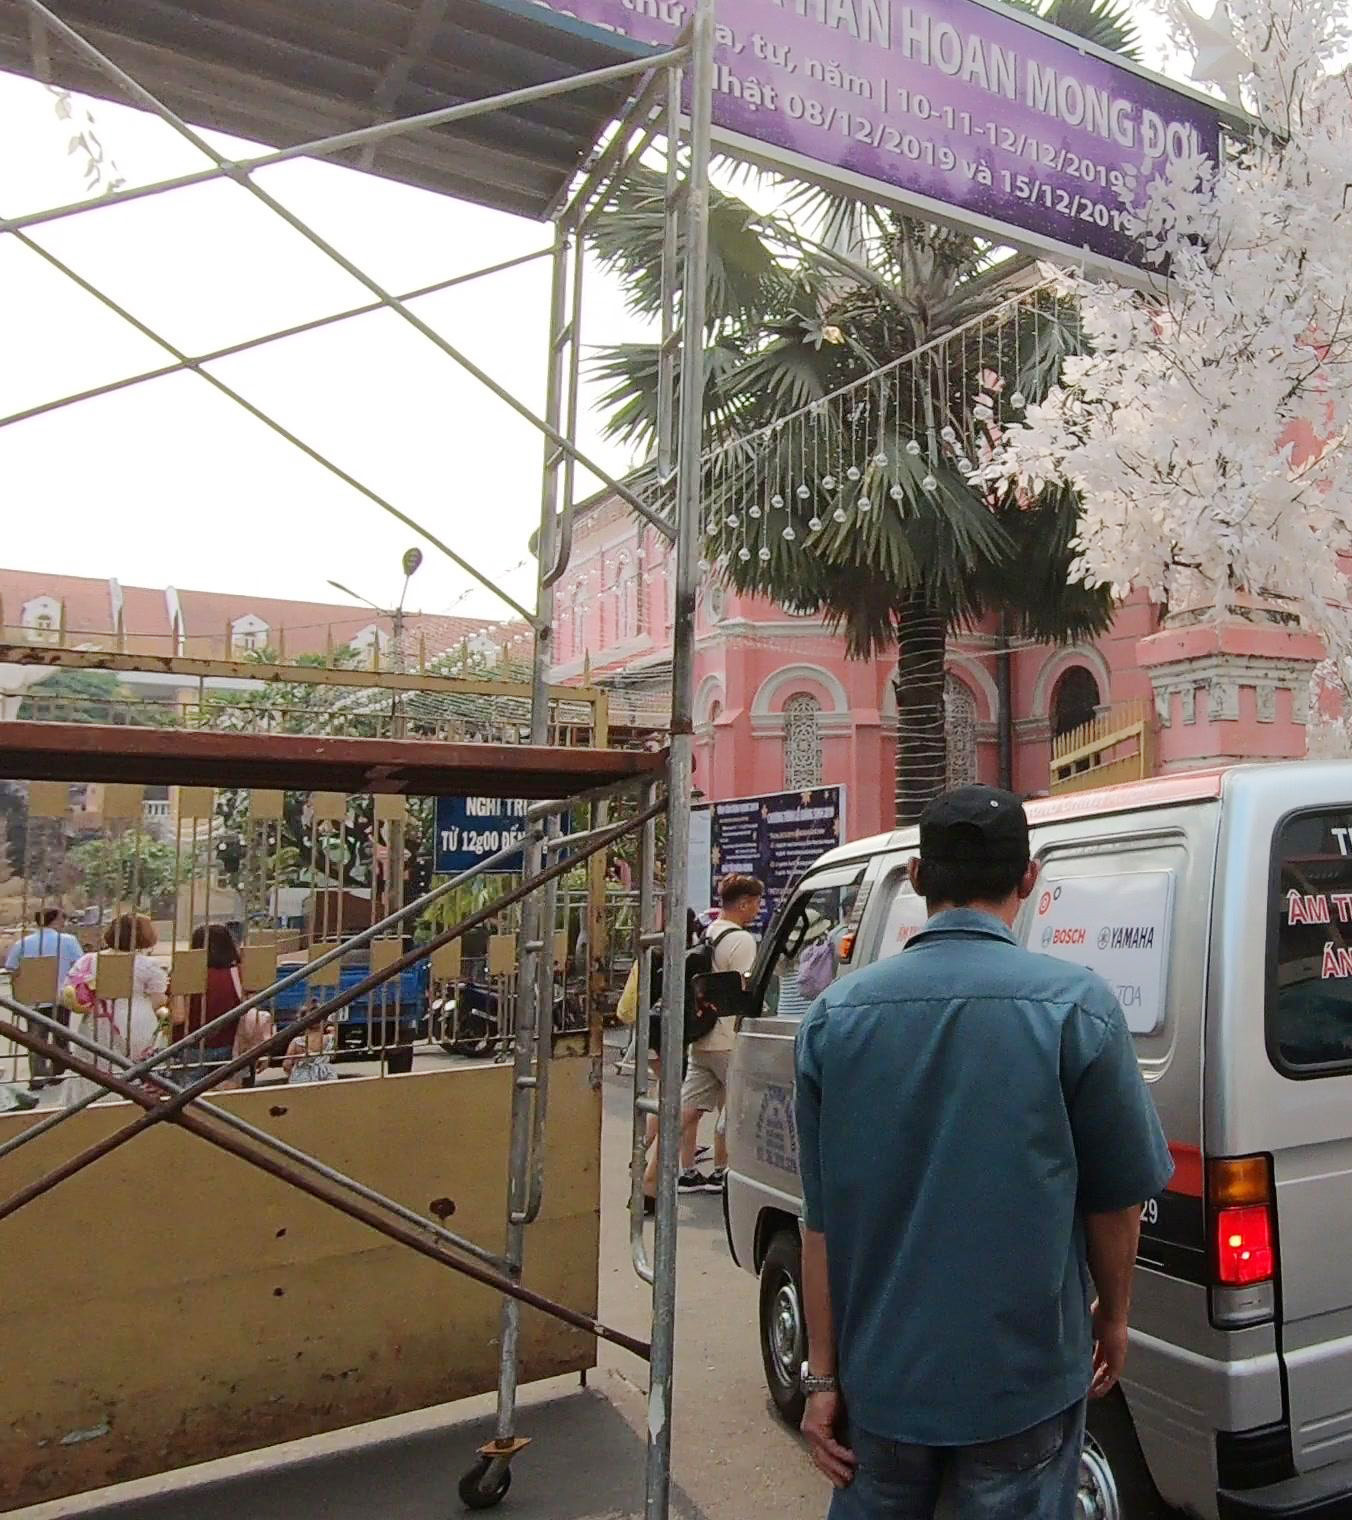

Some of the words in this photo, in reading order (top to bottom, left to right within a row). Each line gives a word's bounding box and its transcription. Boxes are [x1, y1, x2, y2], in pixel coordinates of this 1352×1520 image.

[902, 6, 1017, 100] HOAN
[1026, 60, 1136, 148] MONG
[752, 33, 797, 73] tư,
[807, 56, 873, 98] năm
[898, 87, 1126, 190] 10-11-12/12/2019
[785, 94, 958, 172] 08/12/2019
[962, 160, 993, 188] và
[1001, 168, 1138, 237] 15/12/2019
[441, 825, 460, 852] TỪ
[461, 830, 499, 855] 12g00
[1286, 889, 1331, 926] ÂM
[1052, 928, 1086, 945] BOSCH
[1110, 926, 1155, 949] YAMAHA
